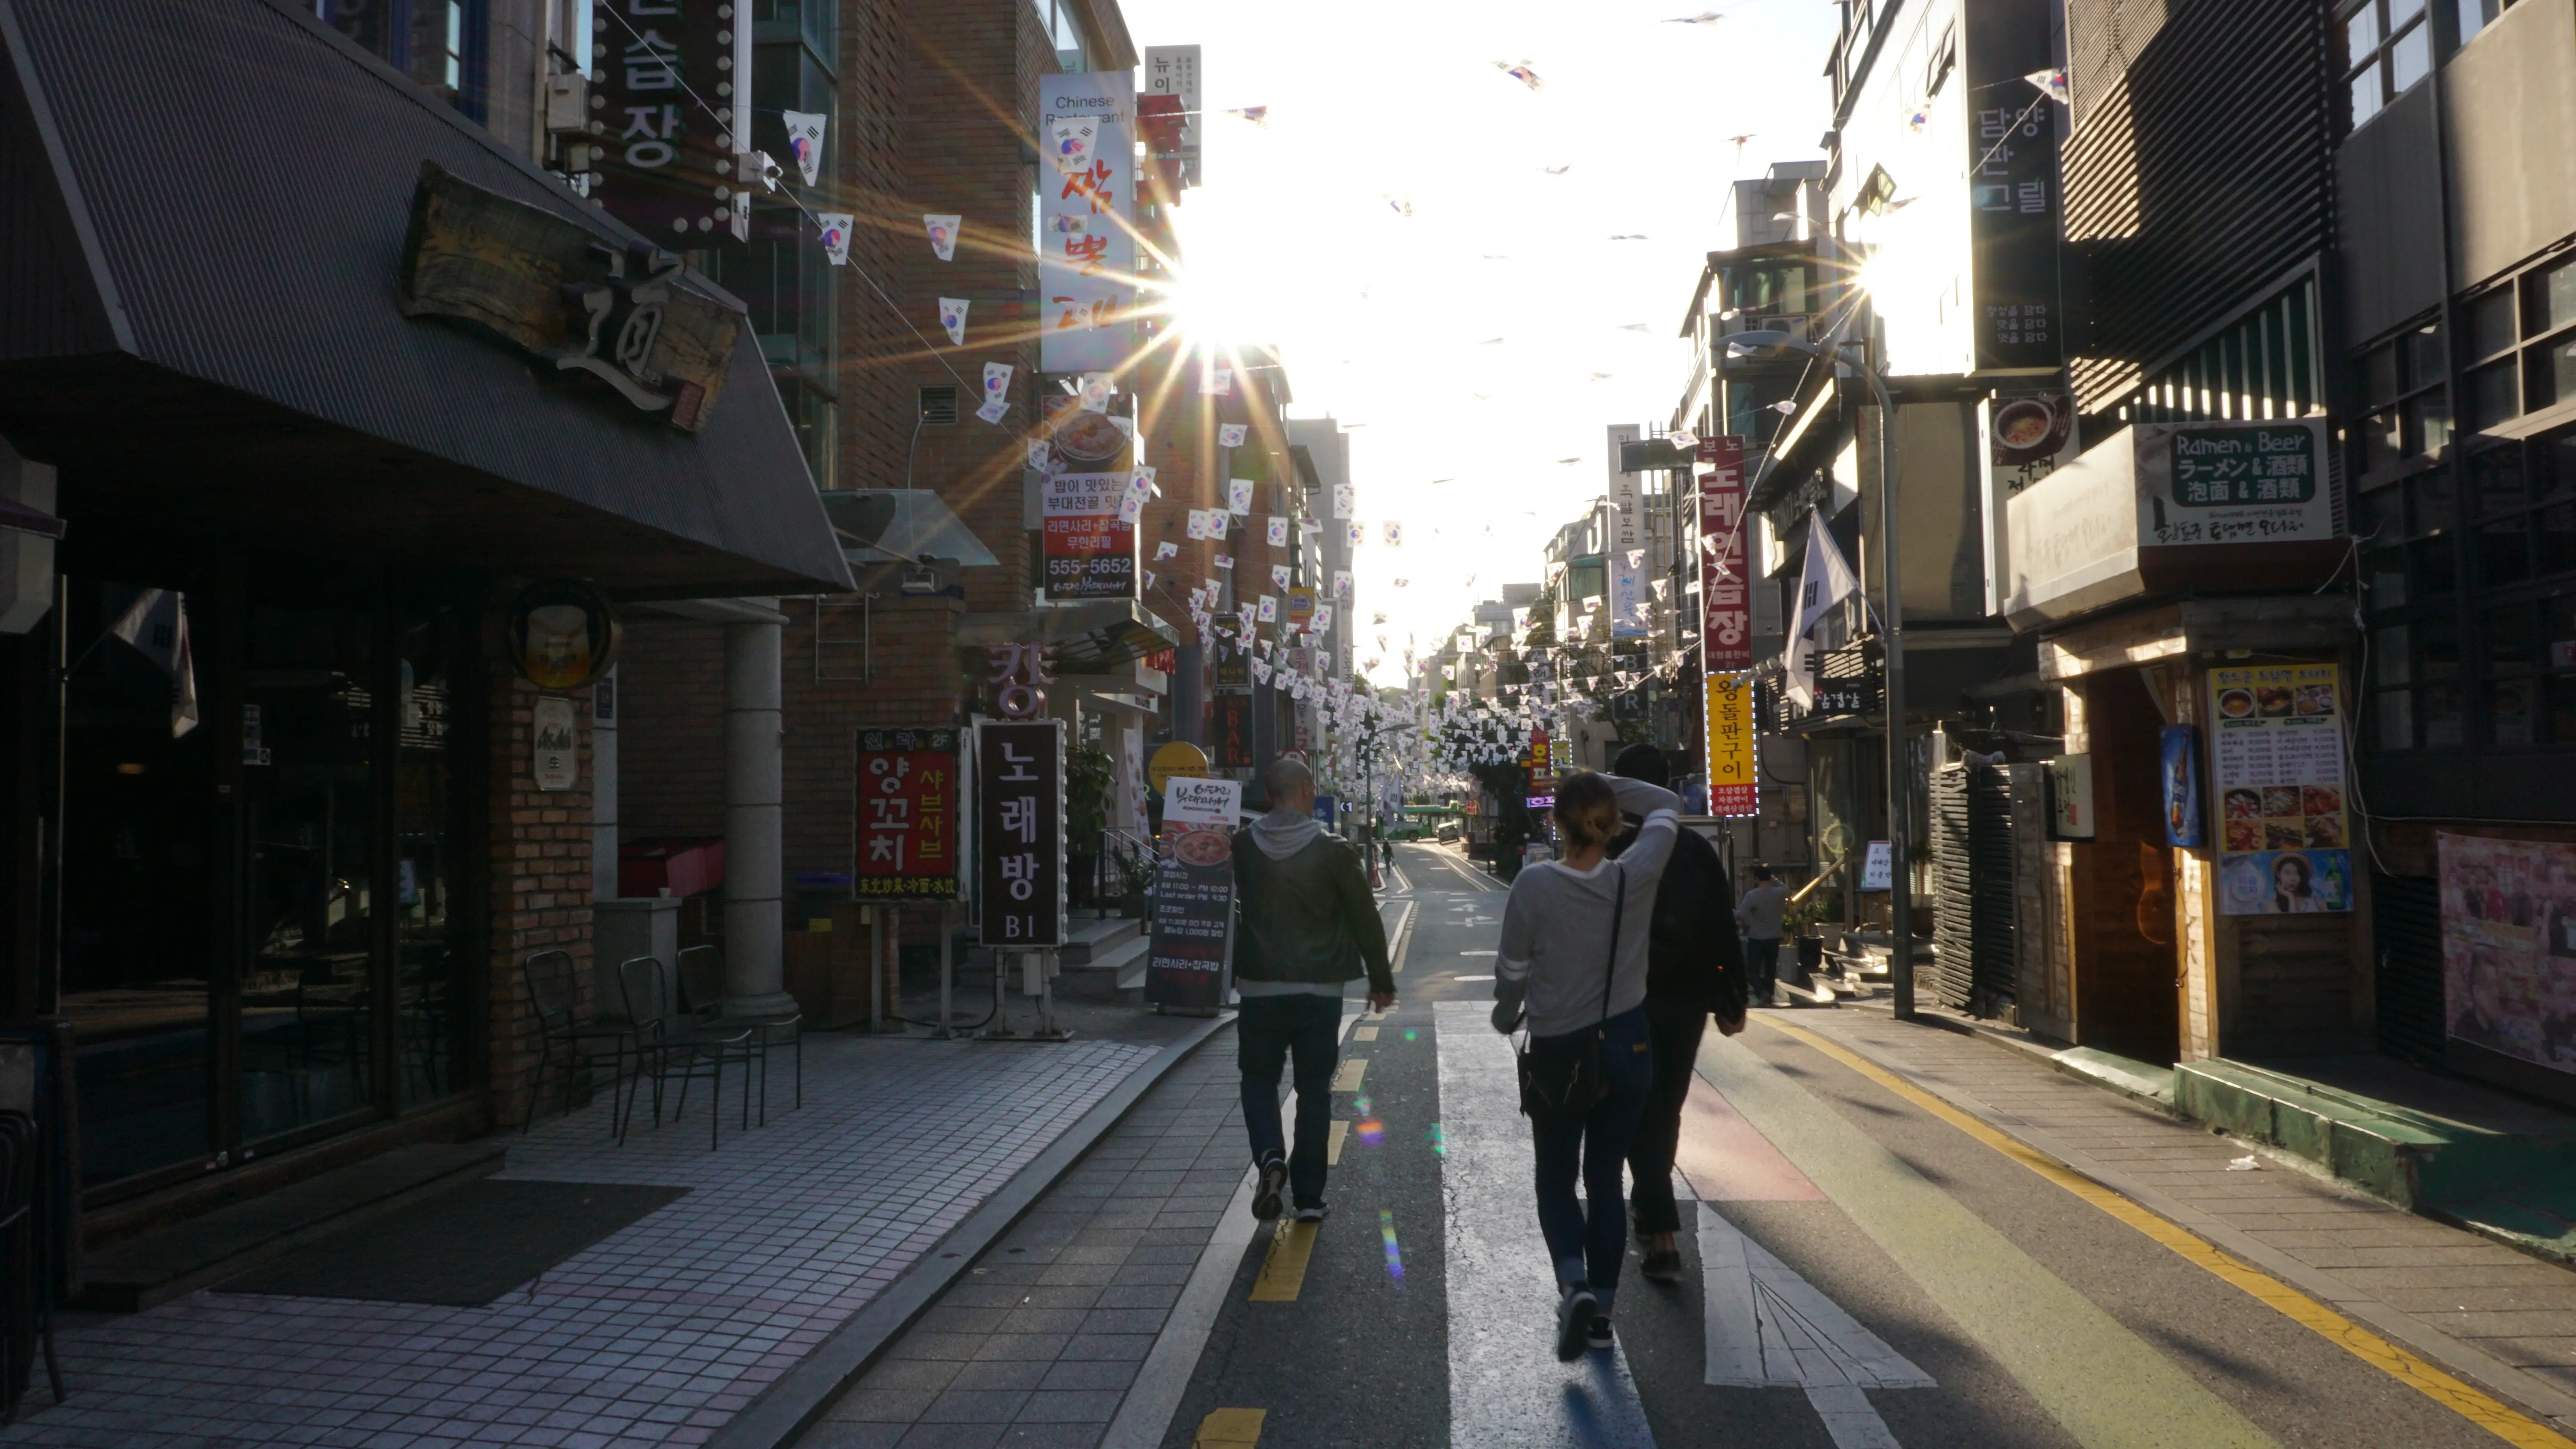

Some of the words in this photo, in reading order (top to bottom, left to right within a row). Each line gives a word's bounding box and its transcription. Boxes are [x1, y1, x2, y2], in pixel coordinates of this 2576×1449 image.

[1056, 96, 1115, 109] Chinese
[1978, 106, 2045, 138] 담양
[1980, 144, 2014, 176] 판
[1981, 180, 2046, 213] 그릴
[2176, 434, 2242, 456] Ramen
[2245, 442, 2253, 453] &
[2258, 431, 2306, 452] Beer
[2178, 457, 2248, 480] ラーメン
[2251, 457, 2263, 476] &
[1054, 479, 1079, 494] 밥이
[1085, 477, 1123, 493] 맛있는
[2187, 480, 2230, 502] 泡面
[2238, 481, 2249, 499] &
[1048, 496, 1099, 511] 부대전골
[1619, 484, 1634, 544] 족발보쌈
[1067, 536, 1112, 549] 무한리필
[1704, 457, 1748, 645] 노래연습장
[1049, 558, 1132, 575] 555-5652
[1624, 654, 1640, 710] BR
[1816, 691, 1860, 710] 삼겹살
[932, 735, 949, 748] 2F
[1715, 679, 1743, 780] 왕돌판구이
[869, 756, 910, 871] 양꼬치
[999, 742, 1040, 902] 노래방
[1160, 891, 1176, 899] Last
